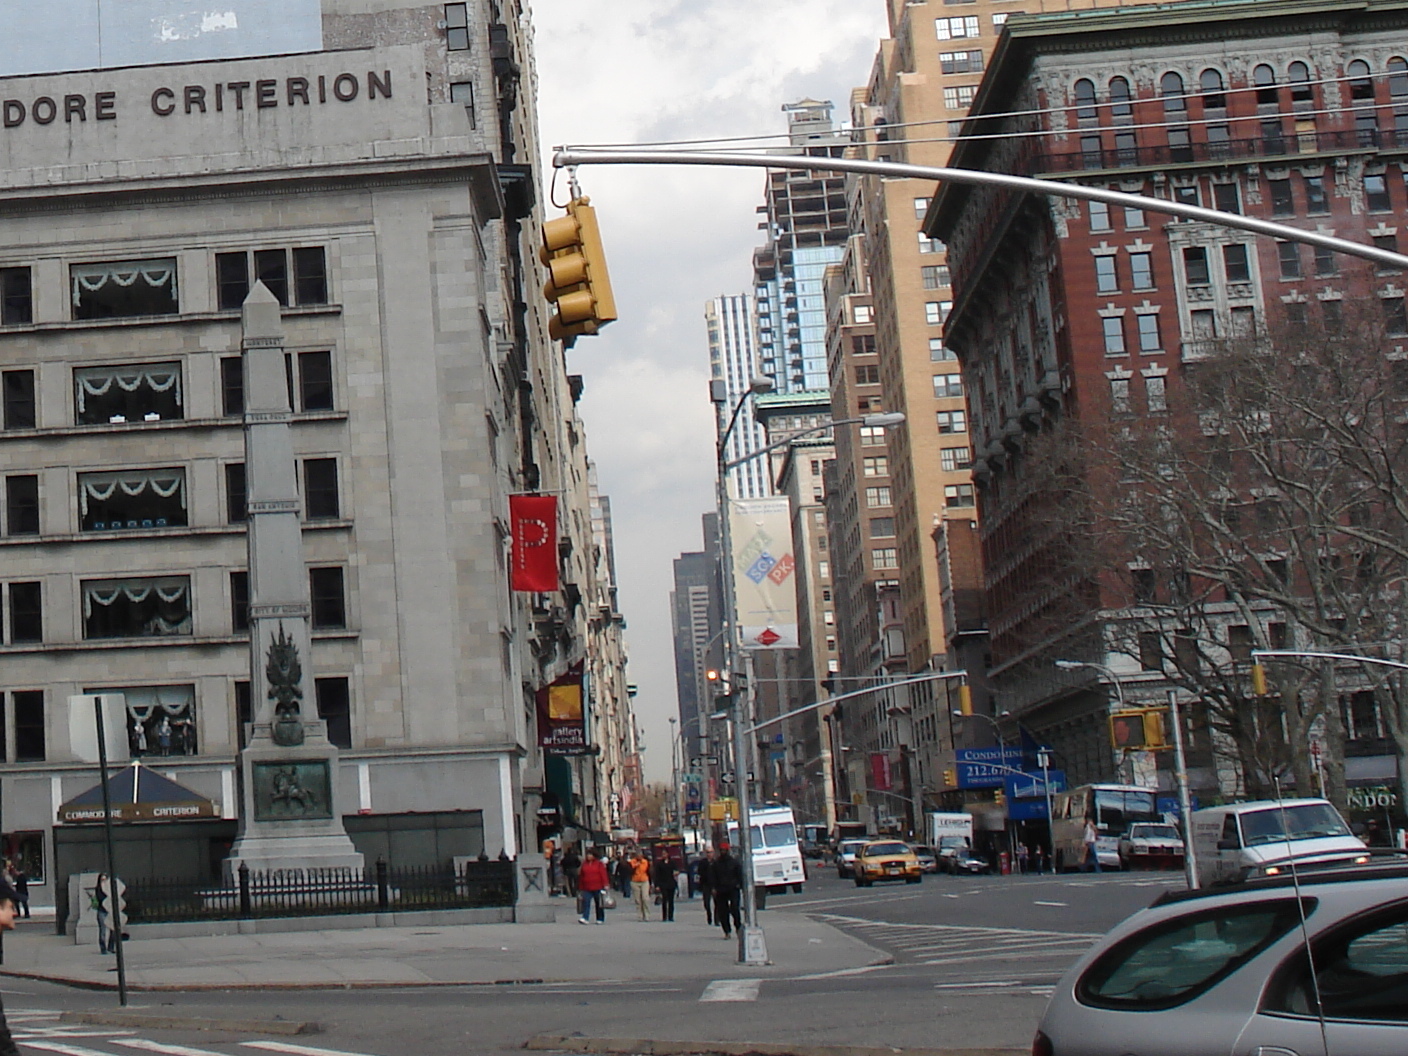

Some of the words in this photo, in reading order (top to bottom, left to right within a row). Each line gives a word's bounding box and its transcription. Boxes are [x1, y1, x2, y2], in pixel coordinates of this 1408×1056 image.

[150, 70, 393, 117] CRITERION
[65, 809, 122, 820] COMMODRE
[153, 805, 200, 817] CRITERION
